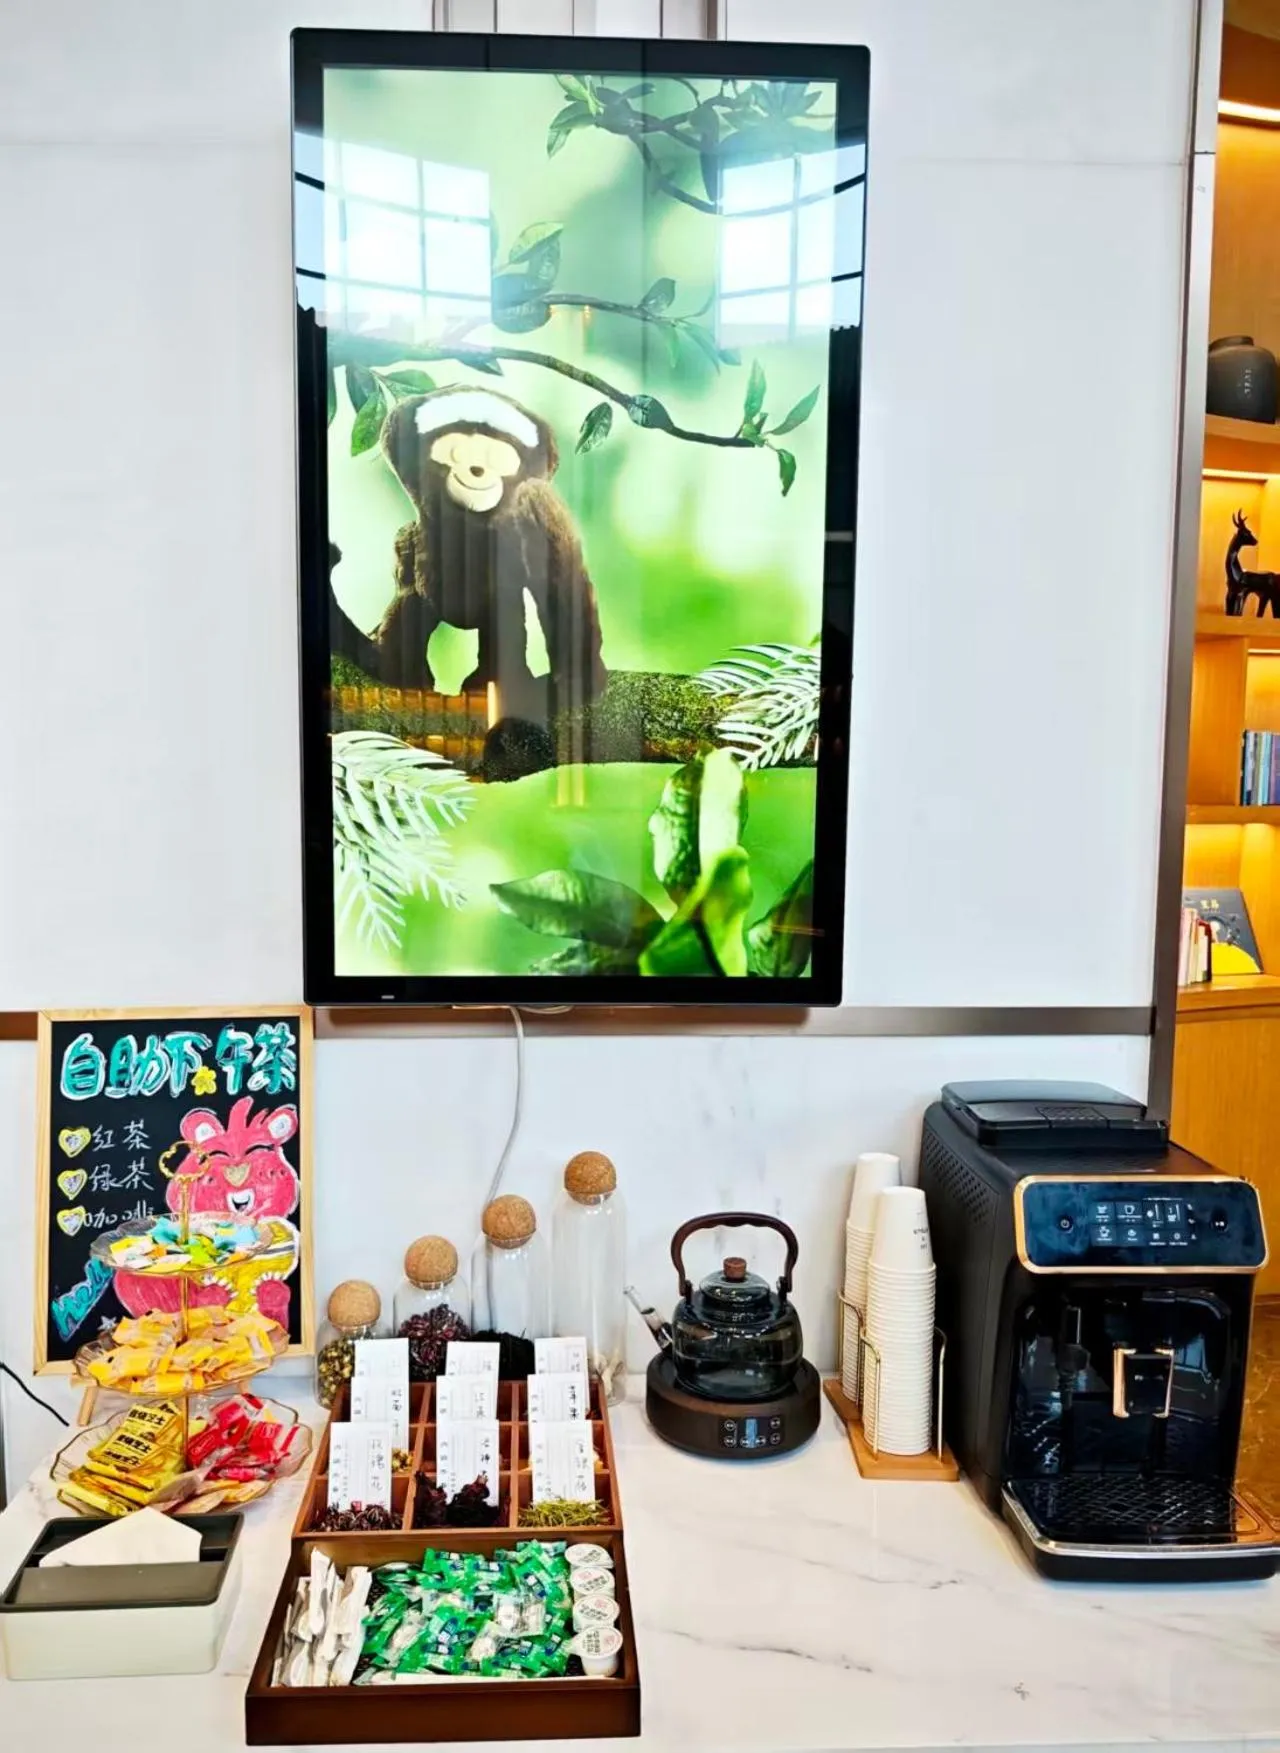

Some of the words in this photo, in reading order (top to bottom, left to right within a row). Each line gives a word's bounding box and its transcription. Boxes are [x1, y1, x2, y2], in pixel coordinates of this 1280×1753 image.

[60, 1022, 297, 1100] 自助下午茶
[92, 1118, 152, 1152] 红茶
[88, 1155, 155, 1192] 绿茶
